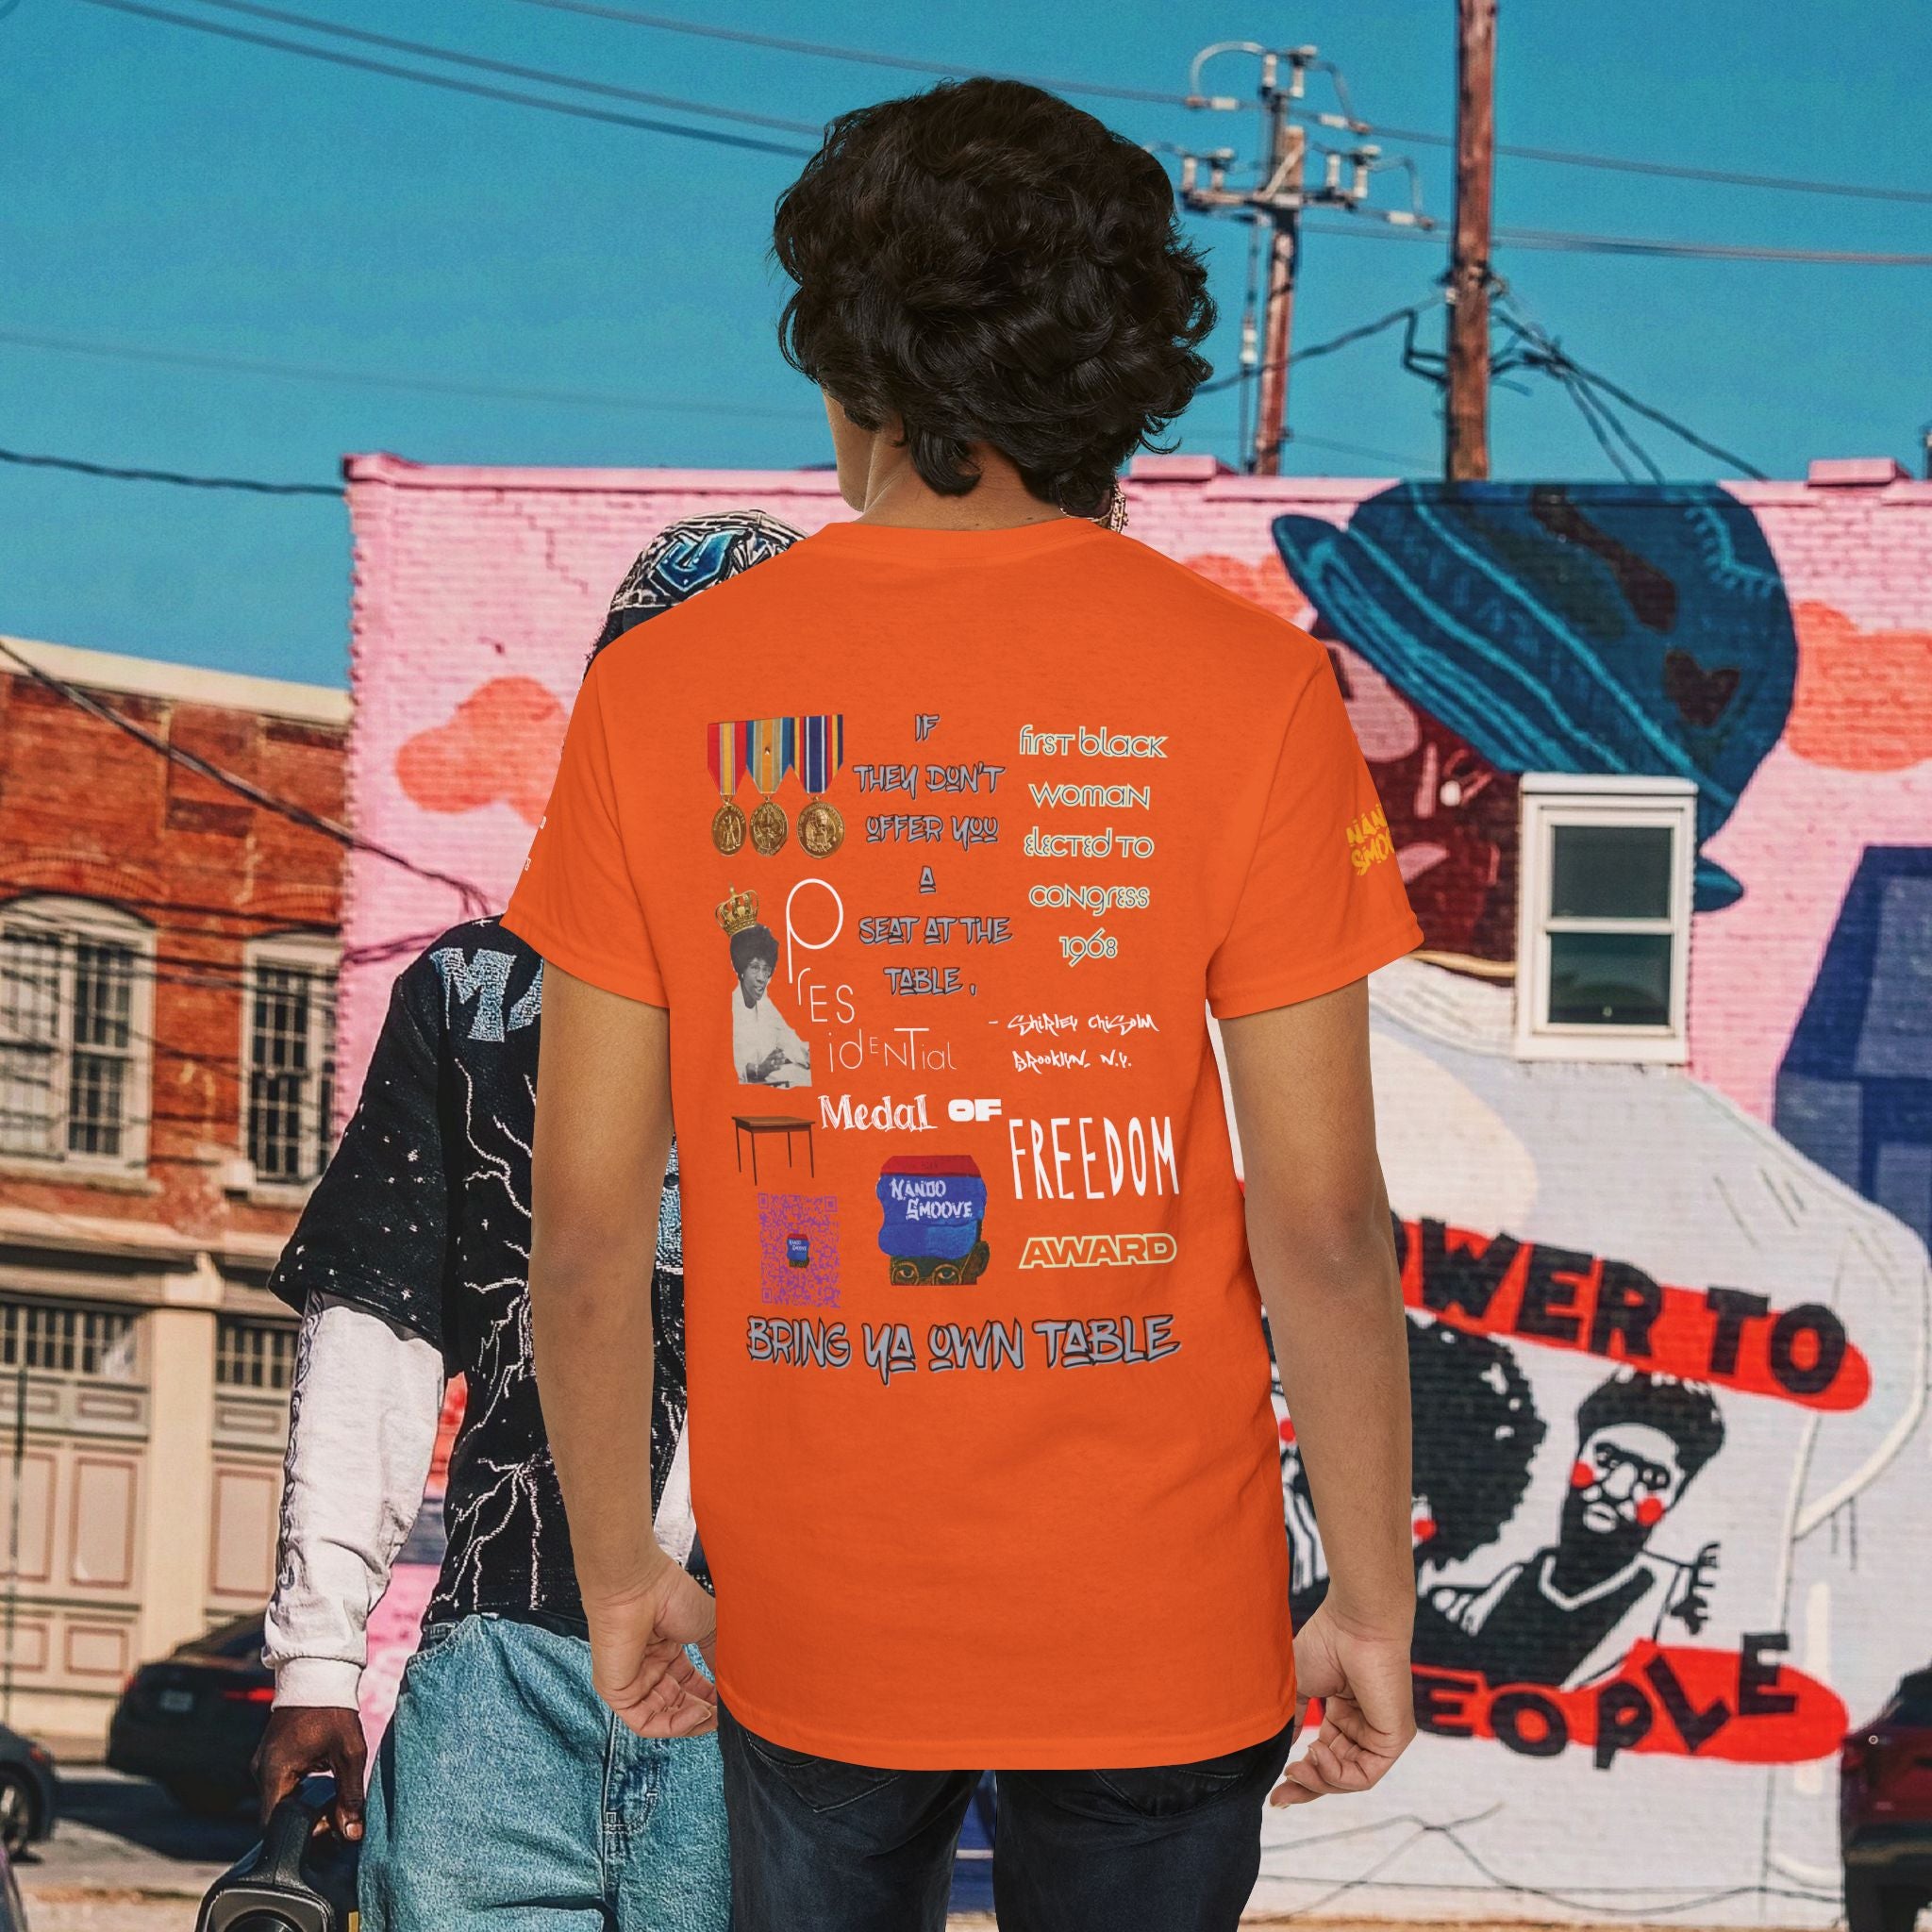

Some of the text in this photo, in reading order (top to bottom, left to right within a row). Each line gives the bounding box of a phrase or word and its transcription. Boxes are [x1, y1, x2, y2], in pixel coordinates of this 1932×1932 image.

[915, 714, 941, 741] IF
[853, 760, 1006, 800] THEY DON'T
[866, 813, 943, 843] OFFER
[951, 815, 999, 852] YOU
[1346, 804, 1388, 847] NAN
[919, 865, 937, 894] A
[858, 915, 1013, 945] SEAT AT THE
[1058, 926, 1118, 968] 1968
[947, 1098, 1002, 1123] OF
[1008, 1116, 1180, 1200] FREEDOM
[889, 1177, 947, 1201] NANDO
[906, 1197, 974, 1221] SMOOVE
[1018, 1232, 1177, 1270] AWARD
[746, 1314, 1182, 1387] BRING YA OWN TABLE
[1706, 1286, 1848, 1395] TO
[1412, 1632, 1800, 1772] EOPLE
